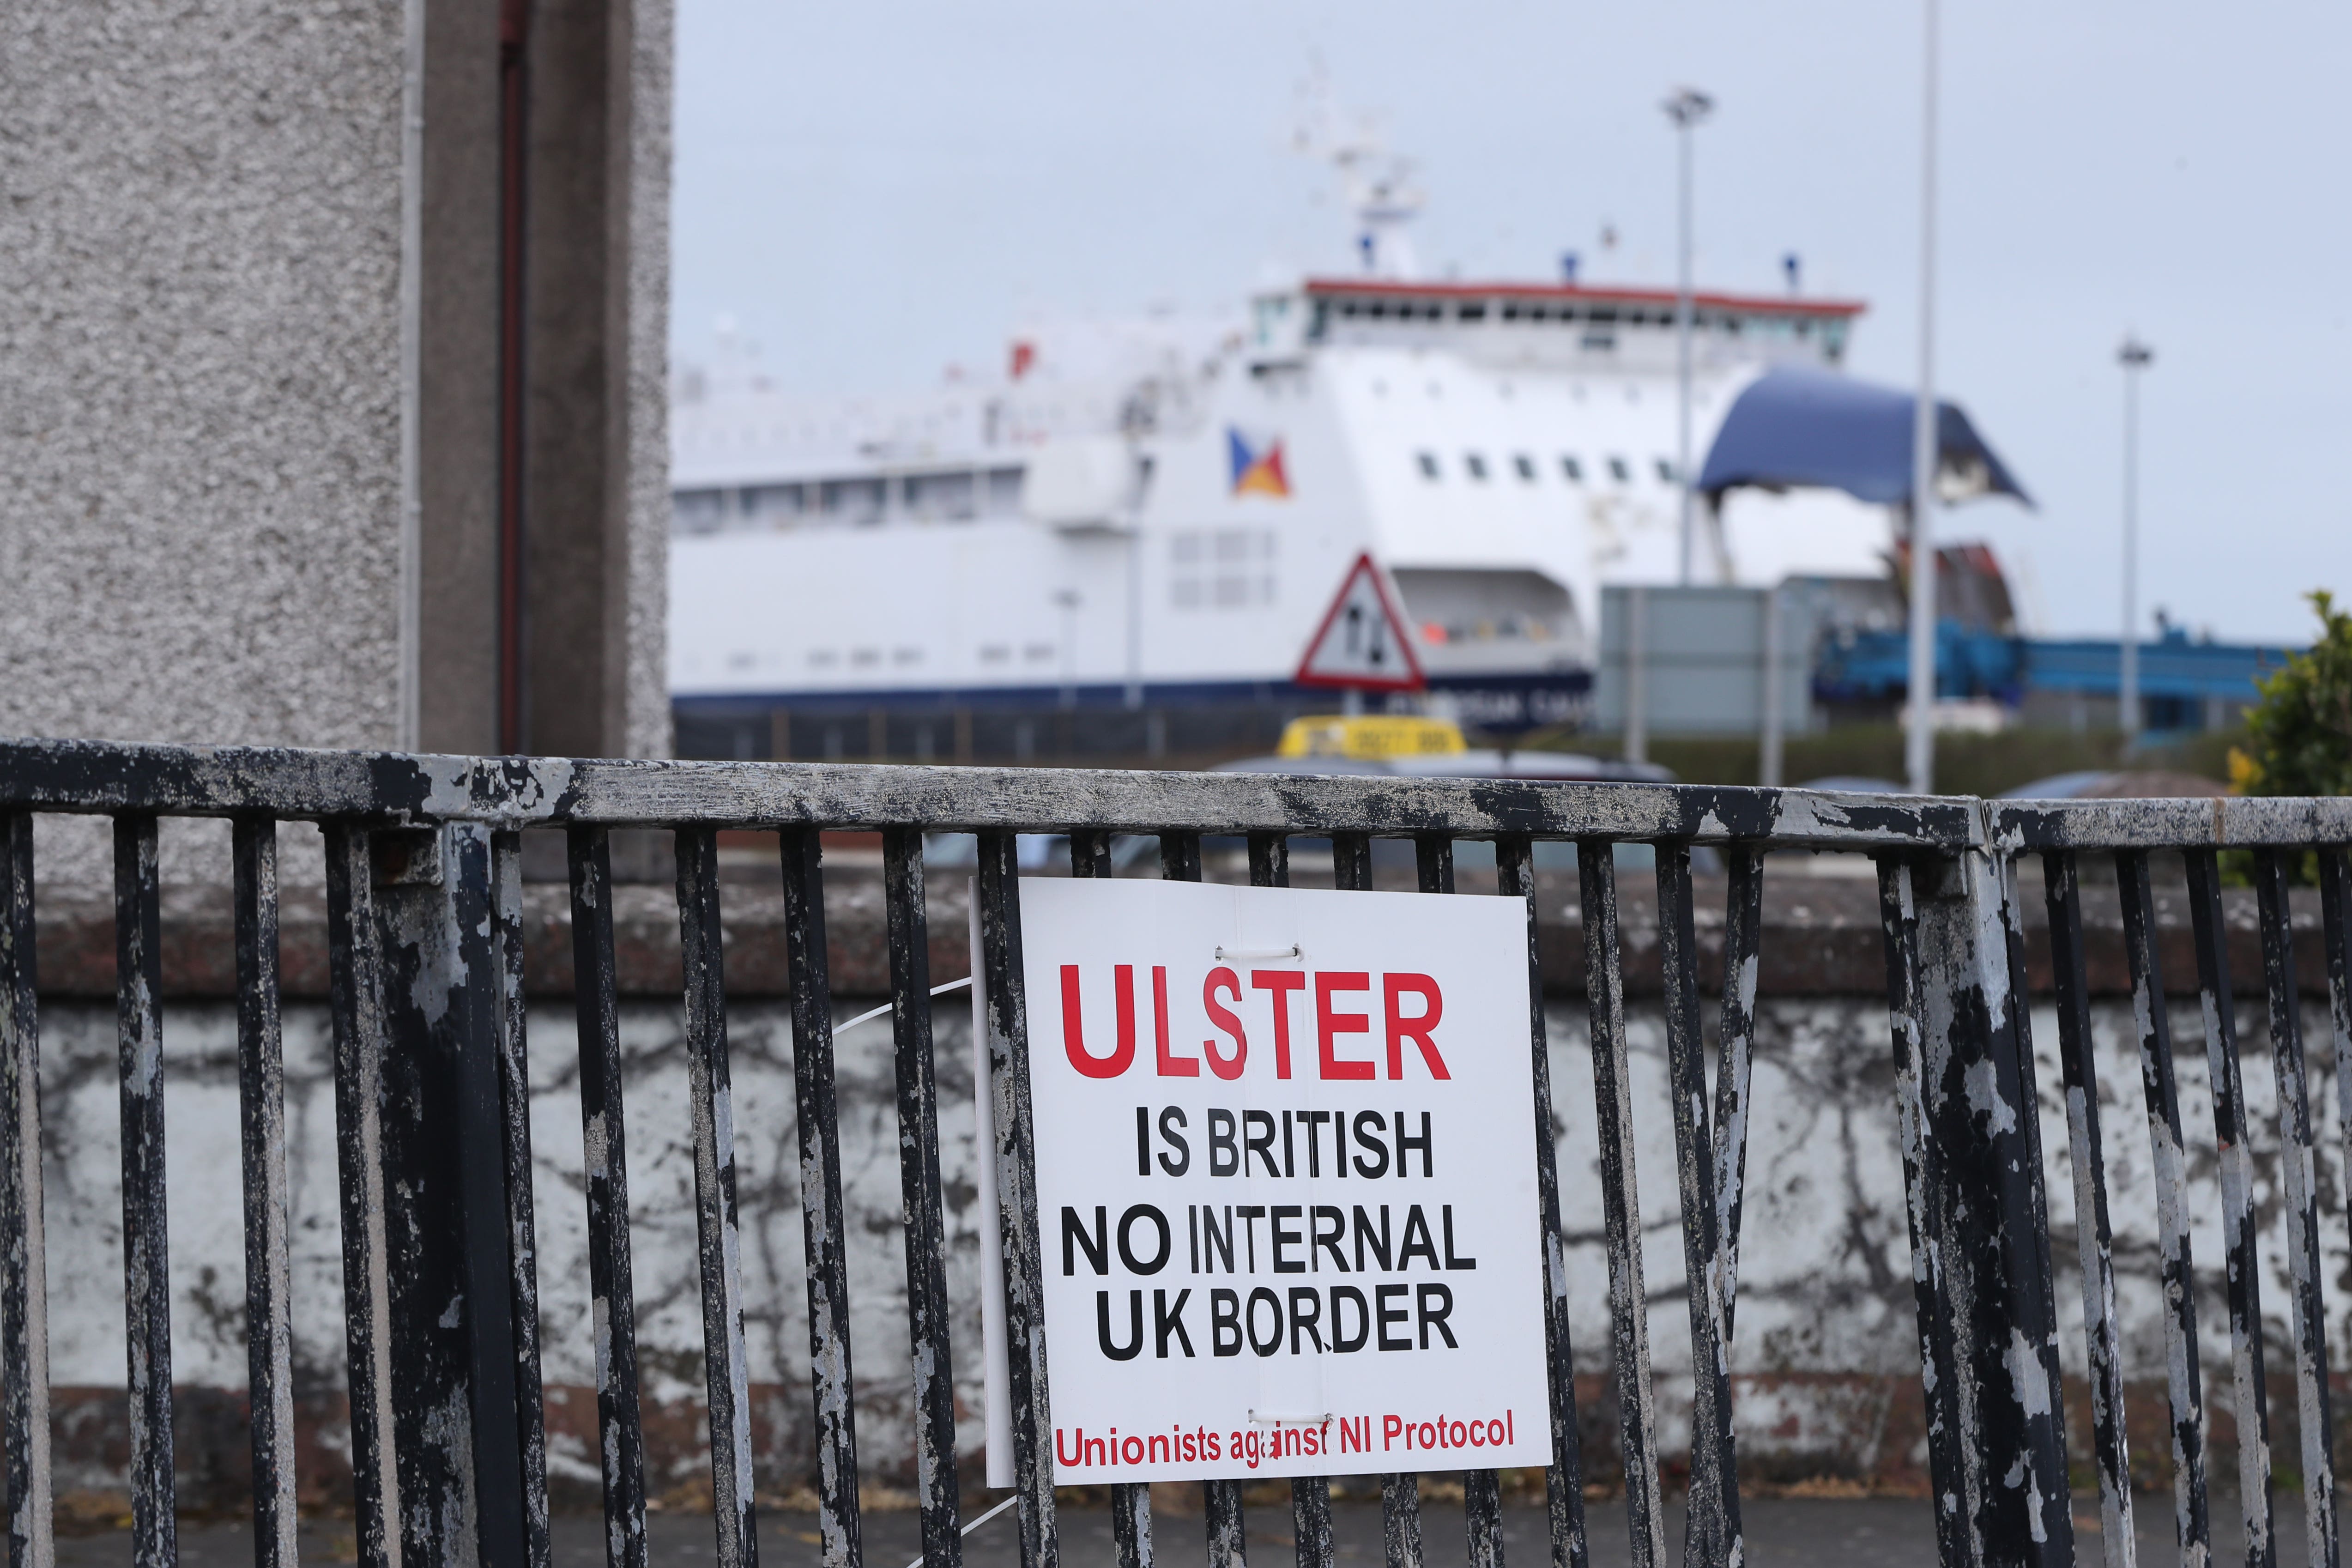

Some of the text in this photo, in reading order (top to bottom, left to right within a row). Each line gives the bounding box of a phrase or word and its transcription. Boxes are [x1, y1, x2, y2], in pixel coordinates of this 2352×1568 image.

[1061, 965, 1451, 1080] ULSTER
[1137, 1106, 1433, 1179] IS BRITISH
[1062, 1204, 1476, 1276] NO INTERNAL
[1097, 1283, 1459, 1361] UK BORDER
[1057, 1426, 1221, 1467] Unionists
[1341, 1416, 1371, 1453] NI
[1384, 1410, 1513, 1452] Protocol
